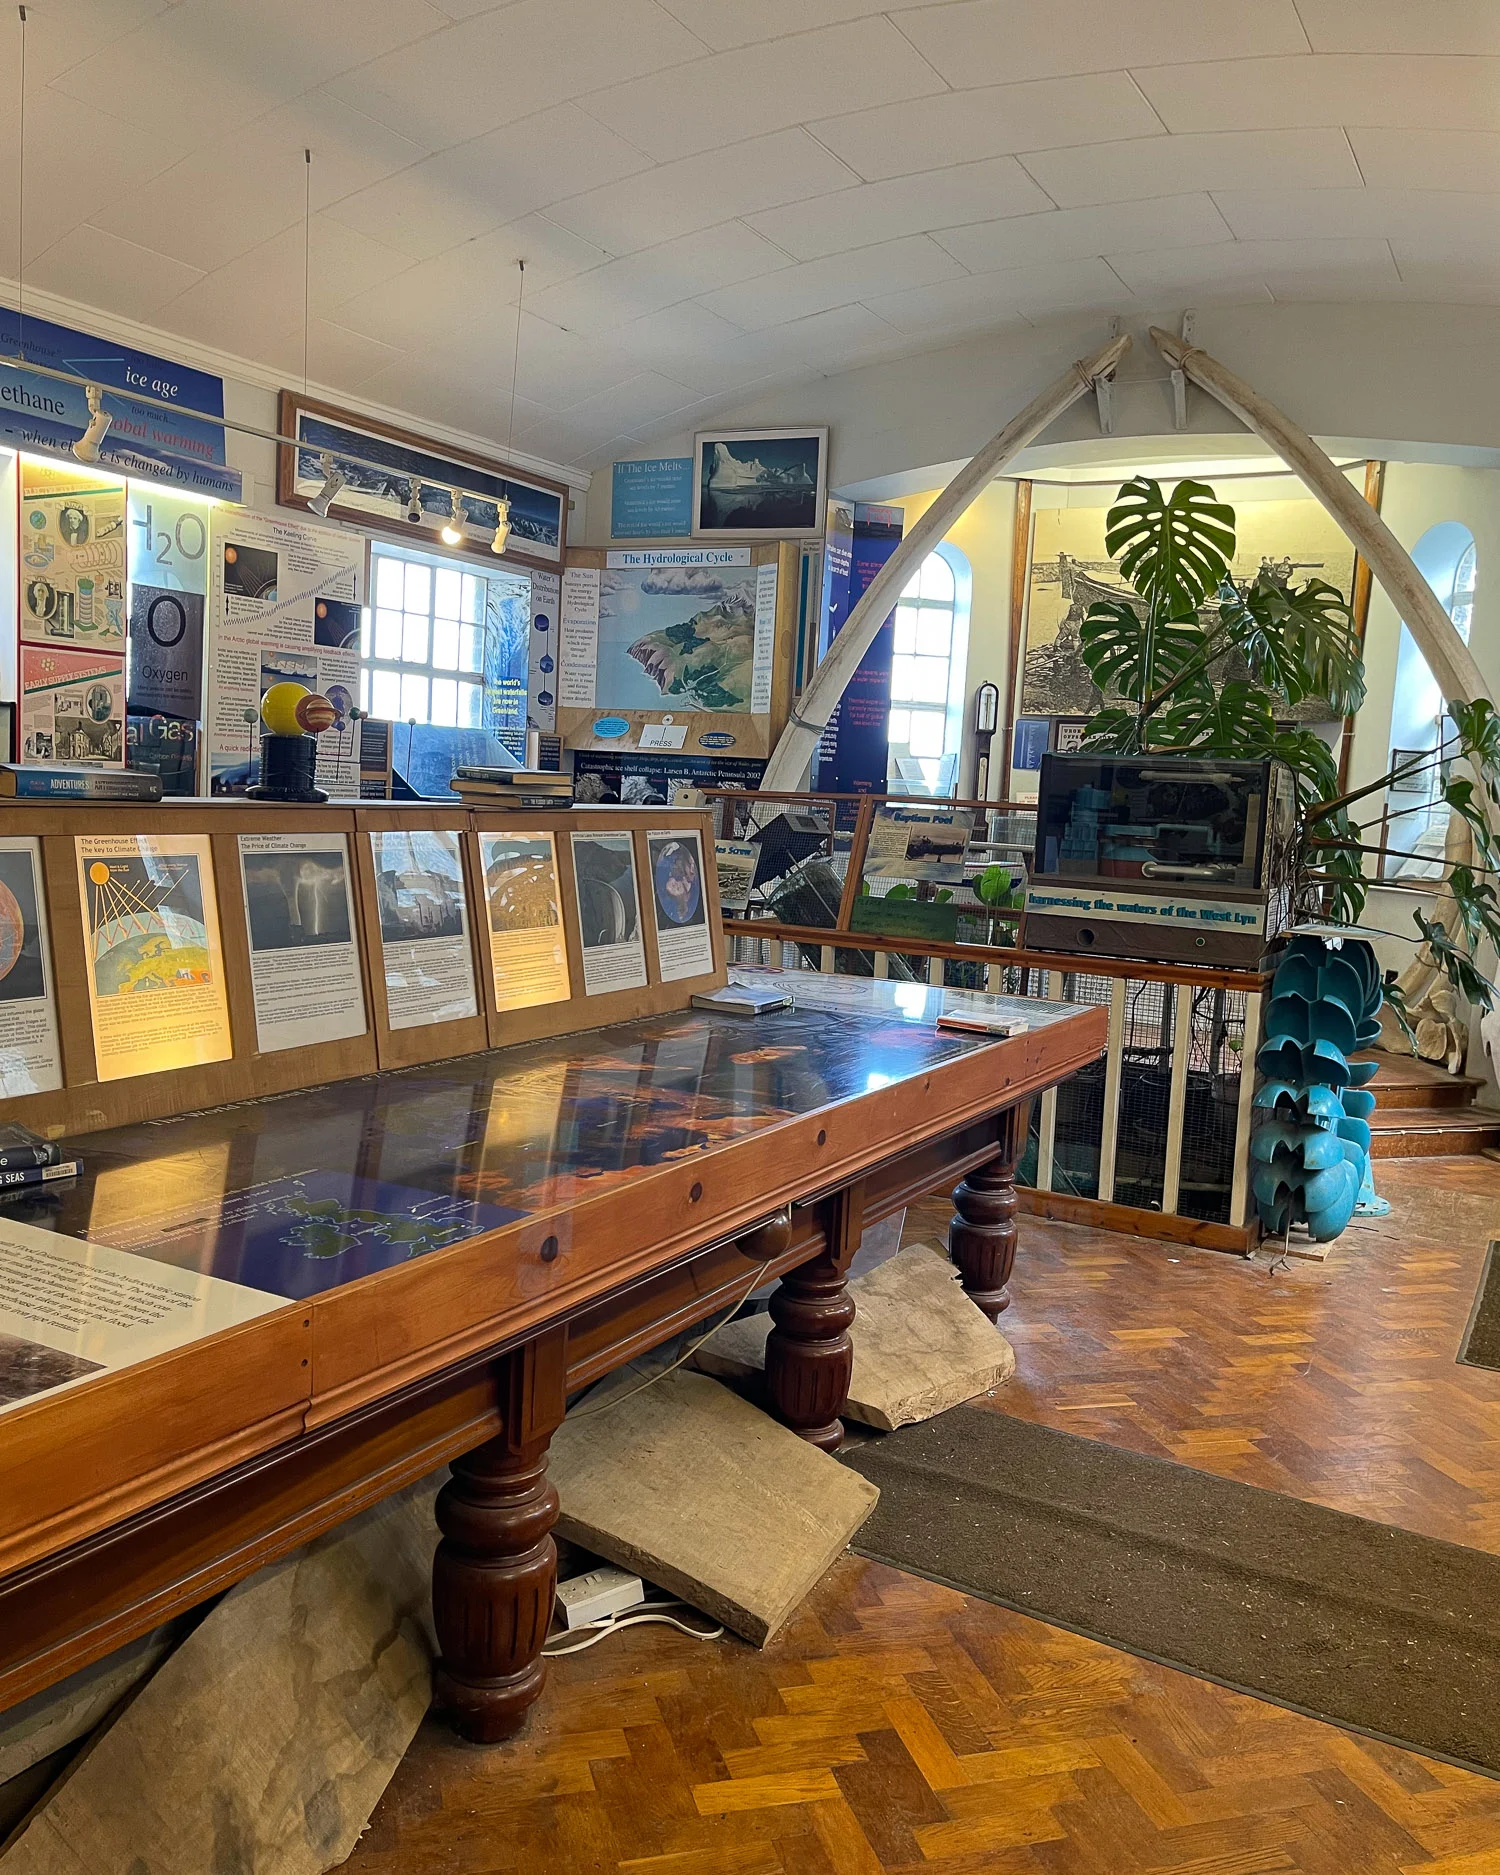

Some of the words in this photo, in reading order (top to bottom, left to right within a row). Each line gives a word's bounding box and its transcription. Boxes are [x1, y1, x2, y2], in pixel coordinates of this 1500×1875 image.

[125, 366, 148, 387] ice
[151, 379, 179, 399] age
[131, 405, 145, 416] too
[22, 430, 57, 448] when
[109, 416, 148, 437] obal
[152, 429, 215, 459] warming
[110, 450, 120, 464] is
[124, 455, 174, 477] changed
[176, 466, 190, 484] by
[192, 470, 234, 492] humans
[626, 463, 642, 474] The
[644, 462, 657, 473] Ice
[272, 526, 283, 535] The
[622, 553, 640, 565] The
[643, 552, 703, 566] Hydrological
[705, 551, 733, 565] Cycle
[562, 617, 597, 626] Evaporation
[25, 677, 49, 690] EARLY
[49, 671, 74, 685] SUPPLY
[74, 666, 107, 680] SYSTEMS
[142, 665, 188, 684] Oxygen
[148, 714, 194, 742] Gas
[580, 761, 613, 772] Catastrophic
[624, 764, 638, 773] shelf
[638, 765, 663, 775] collapse:
[663, 767, 682, 775] Larsen
[691, 769, 717, 778] Antarctic
[717, 770, 745, 780] Peninsula
[50, 778, 90, 791] ADVENTURES
[893, 812, 931, 824] Baptism
[932, 814, 954, 825] Pool
[94, 837, 128, 845] Greenhouse
[114, 845, 137, 853] Climate
[1028, 892, 1091, 911] harnessing
[1094, 898, 1113, 911] the
[1117, 902, 1157, 915] waters
[1160, 905, 1175, 916] of
[1176, 906, 1197, 919] the
[1199, 908, 1232, 923] West
[1234, 912, 1257, 926] Lyn
[142, 1115, 186, 1127] The
[186, 1103, 241, 1119] World
[236, 1090, 302, 1107] Without
[299, 1083, 331, 1094] Ice
[5, 1171, 25, 1185] SEAS
